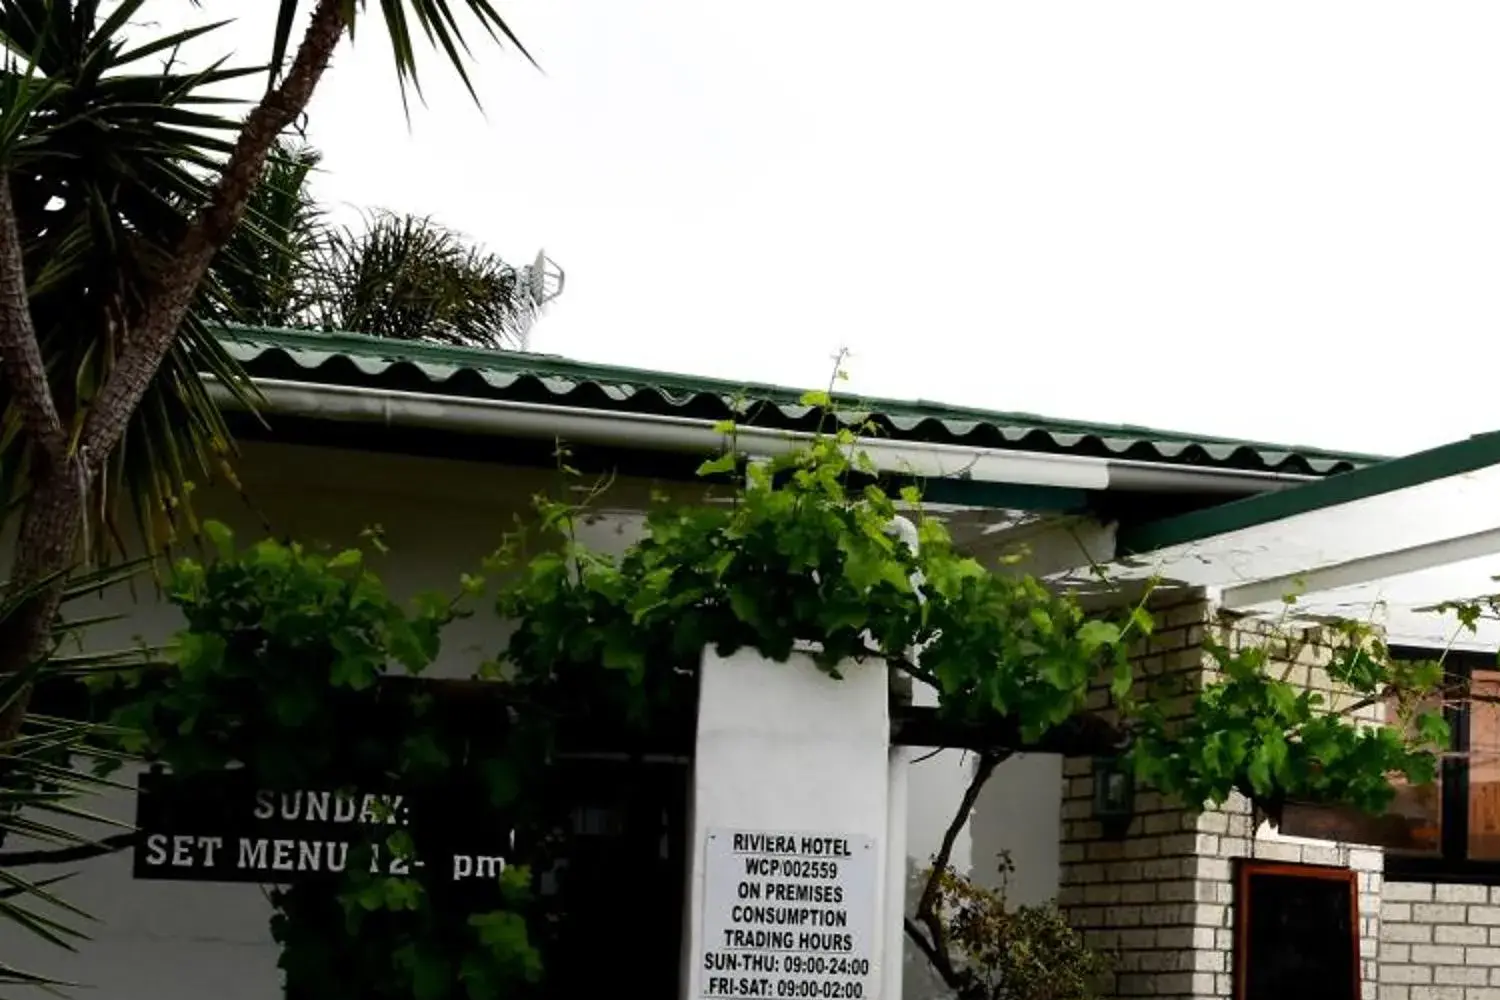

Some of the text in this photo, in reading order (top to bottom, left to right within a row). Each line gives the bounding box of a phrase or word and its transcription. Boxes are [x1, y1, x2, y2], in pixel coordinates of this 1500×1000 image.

[146, 835, 222, 868] SET
[237, 838, 349, 873] MENU
[733, 833, 852, 856] RIVIERA HOTEL
[738, 881, 843, 903] ON PREMISES
[732, 905, 847, 927] CONSUMPTION
[724, 929, 853, 951] TRADING HOURS
[704, 952, 869, 975] SUN-THU: 09:00-24:00
[709, 977, 863, 999] FRI-SAT: 09:00-02:00
